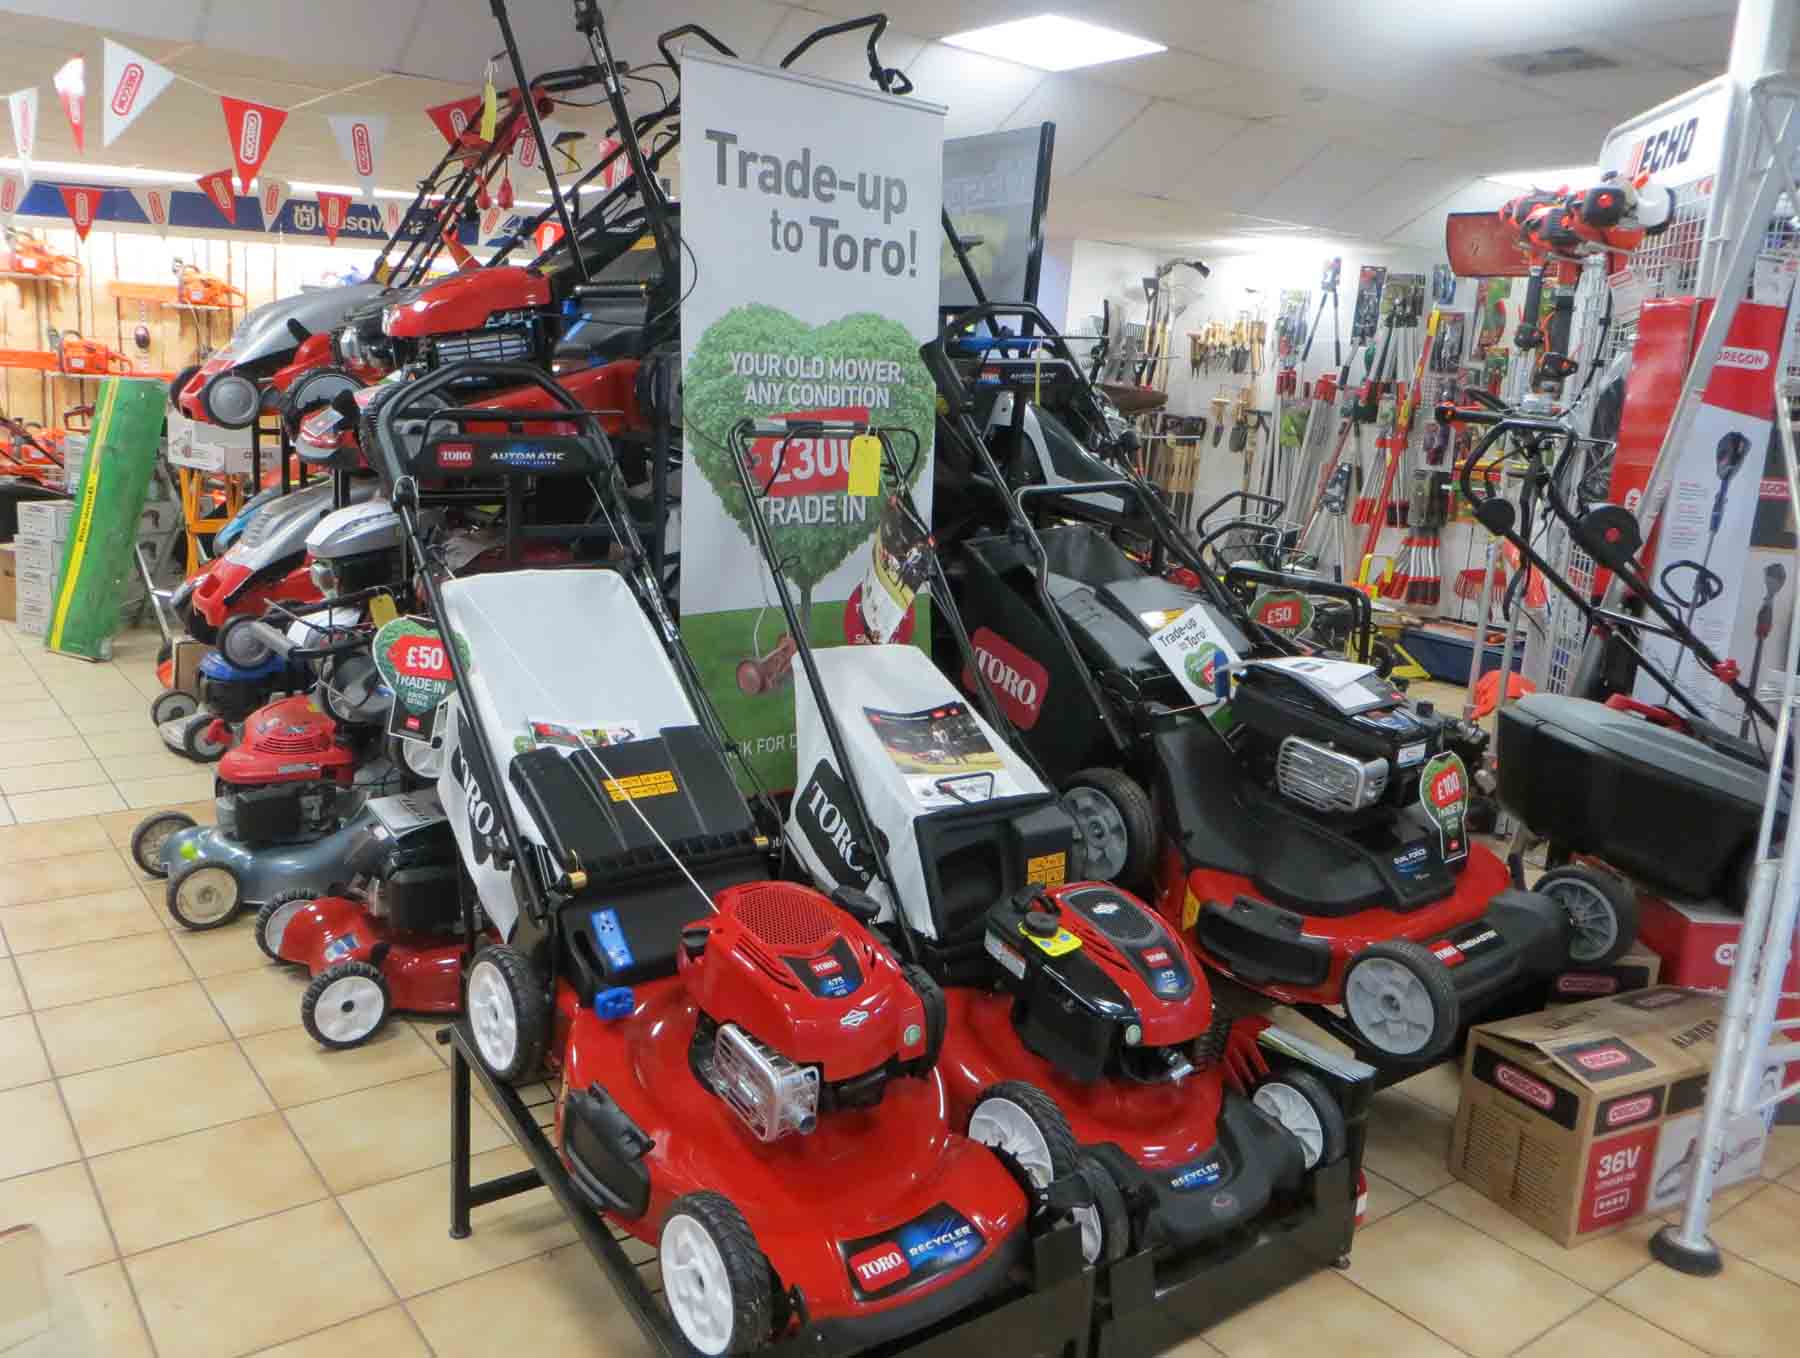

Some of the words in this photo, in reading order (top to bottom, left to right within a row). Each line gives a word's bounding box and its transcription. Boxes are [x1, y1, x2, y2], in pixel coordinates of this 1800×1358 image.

[1639, 116, 1699, 174] ECHO
[705, 128, 909, 225] Trade-up
[770, 208, 804, 252] to
[809, 215, 918, 278] Toro!
[730, 352, 782, 377] YOUR
[785, 355, 825, 380] OLD
[829, 359, 905, 384] MOWER,
[744, 382, 783, 406] ANY
[787, 383, 889, 409] CONDITION
[442, 450, 472, 461] TORO
[489, 450, 566, 461] AUTOMATIC
[757, 497, 836, 526] TRADE
[843, 495, 867, 522] IN
[1160, 617, 1197, 648] Trade-up
[406, 644, 444, 671] £50
[395, 671, 432, 694] TRADE
[433, 680, 448, 695] IN
[975, 647, 1037, 705] TORO
[757, 735, 785, 752] FOR
[1437, 771, 1459, 801] £100
[1597, 1146, 1641, 1179] 36V
[908, 1223, 972, 1258] RECYCLER
[857, 1250, 905, 1280] TORO
